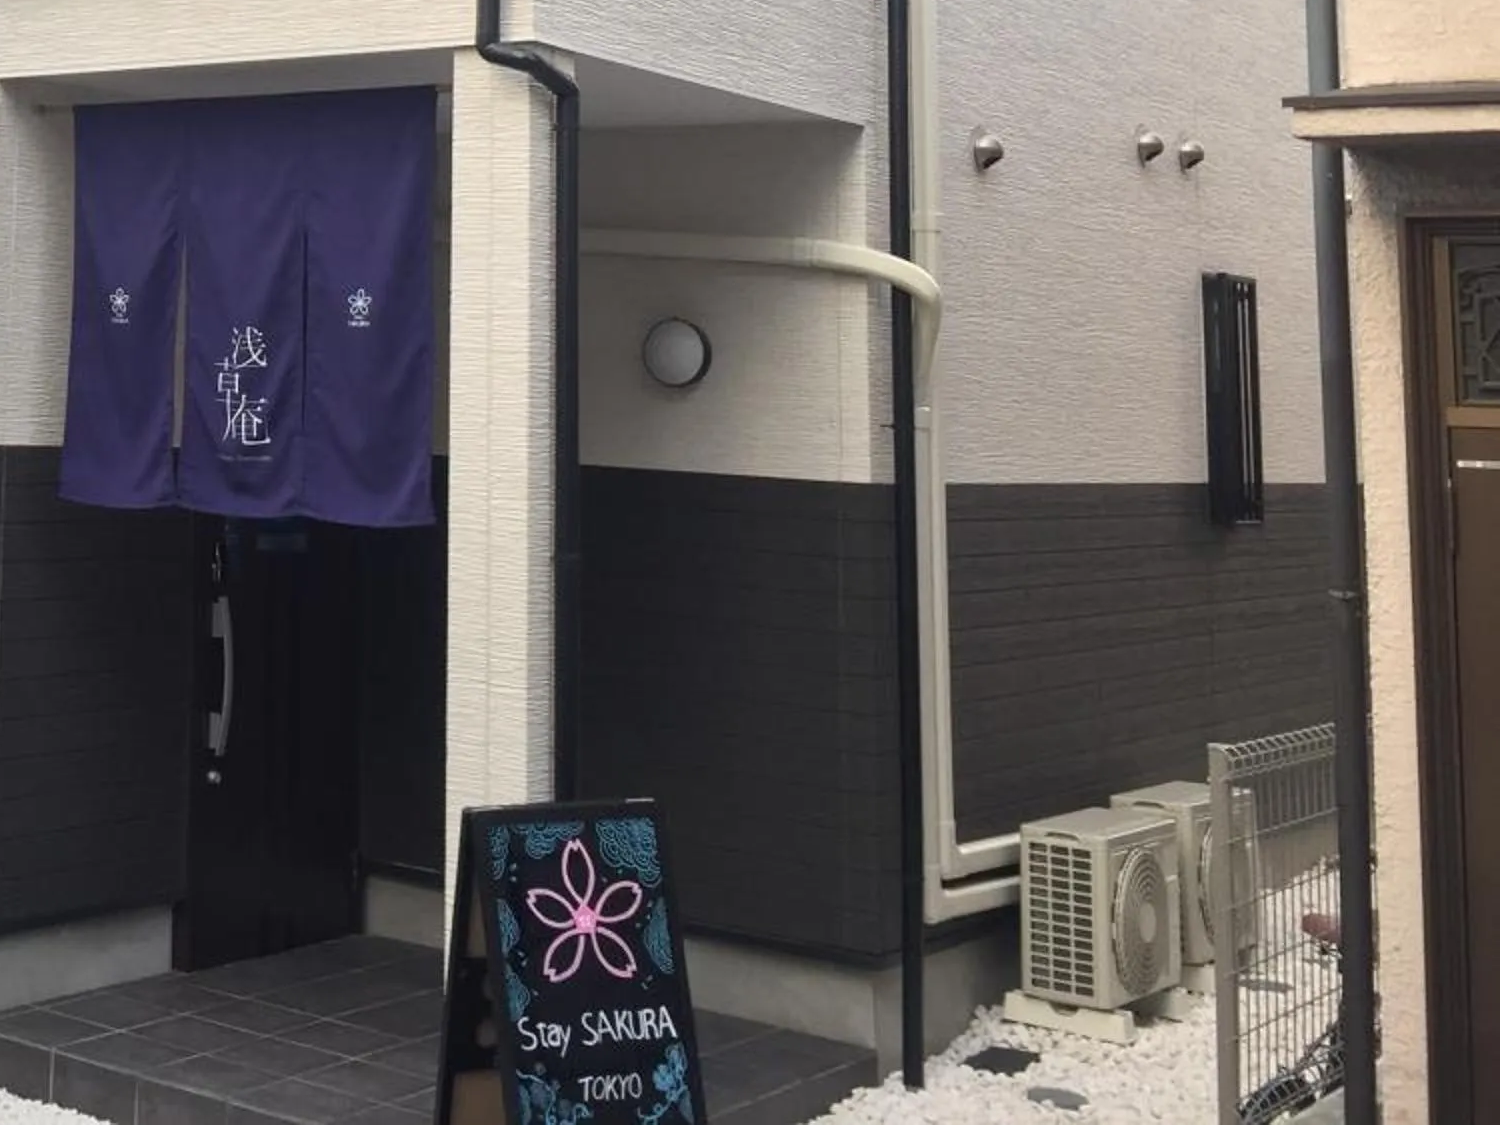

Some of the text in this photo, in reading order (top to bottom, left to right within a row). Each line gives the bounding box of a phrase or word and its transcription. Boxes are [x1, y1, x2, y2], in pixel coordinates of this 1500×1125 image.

[517, 1006, 678, 1057] Stay SAKURA
[577, 1072, 643, 1102] TOKYO
